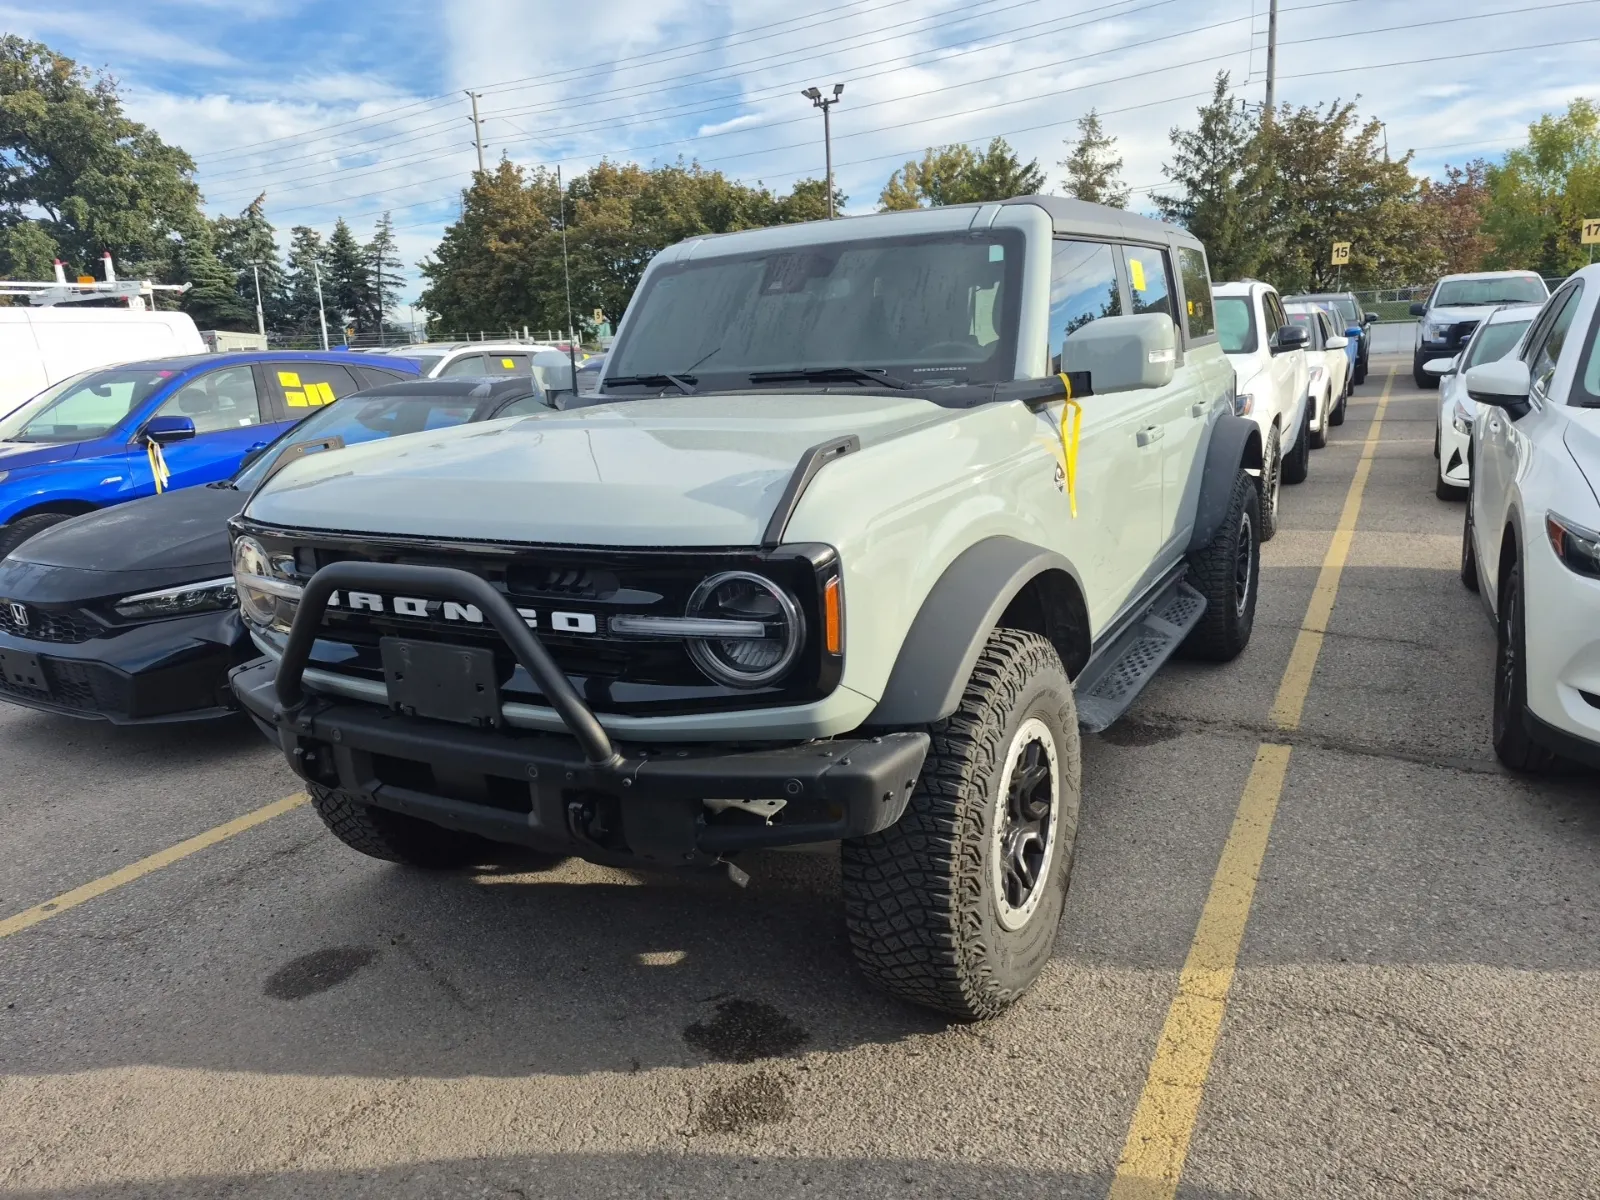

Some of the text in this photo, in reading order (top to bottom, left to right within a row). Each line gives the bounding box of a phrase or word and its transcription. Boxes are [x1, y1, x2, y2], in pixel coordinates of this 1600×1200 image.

[1584, 223, 1600, 236] 17
[1334, 246, 1348, 258] 15
[327, 589, 597, 634] RONO
